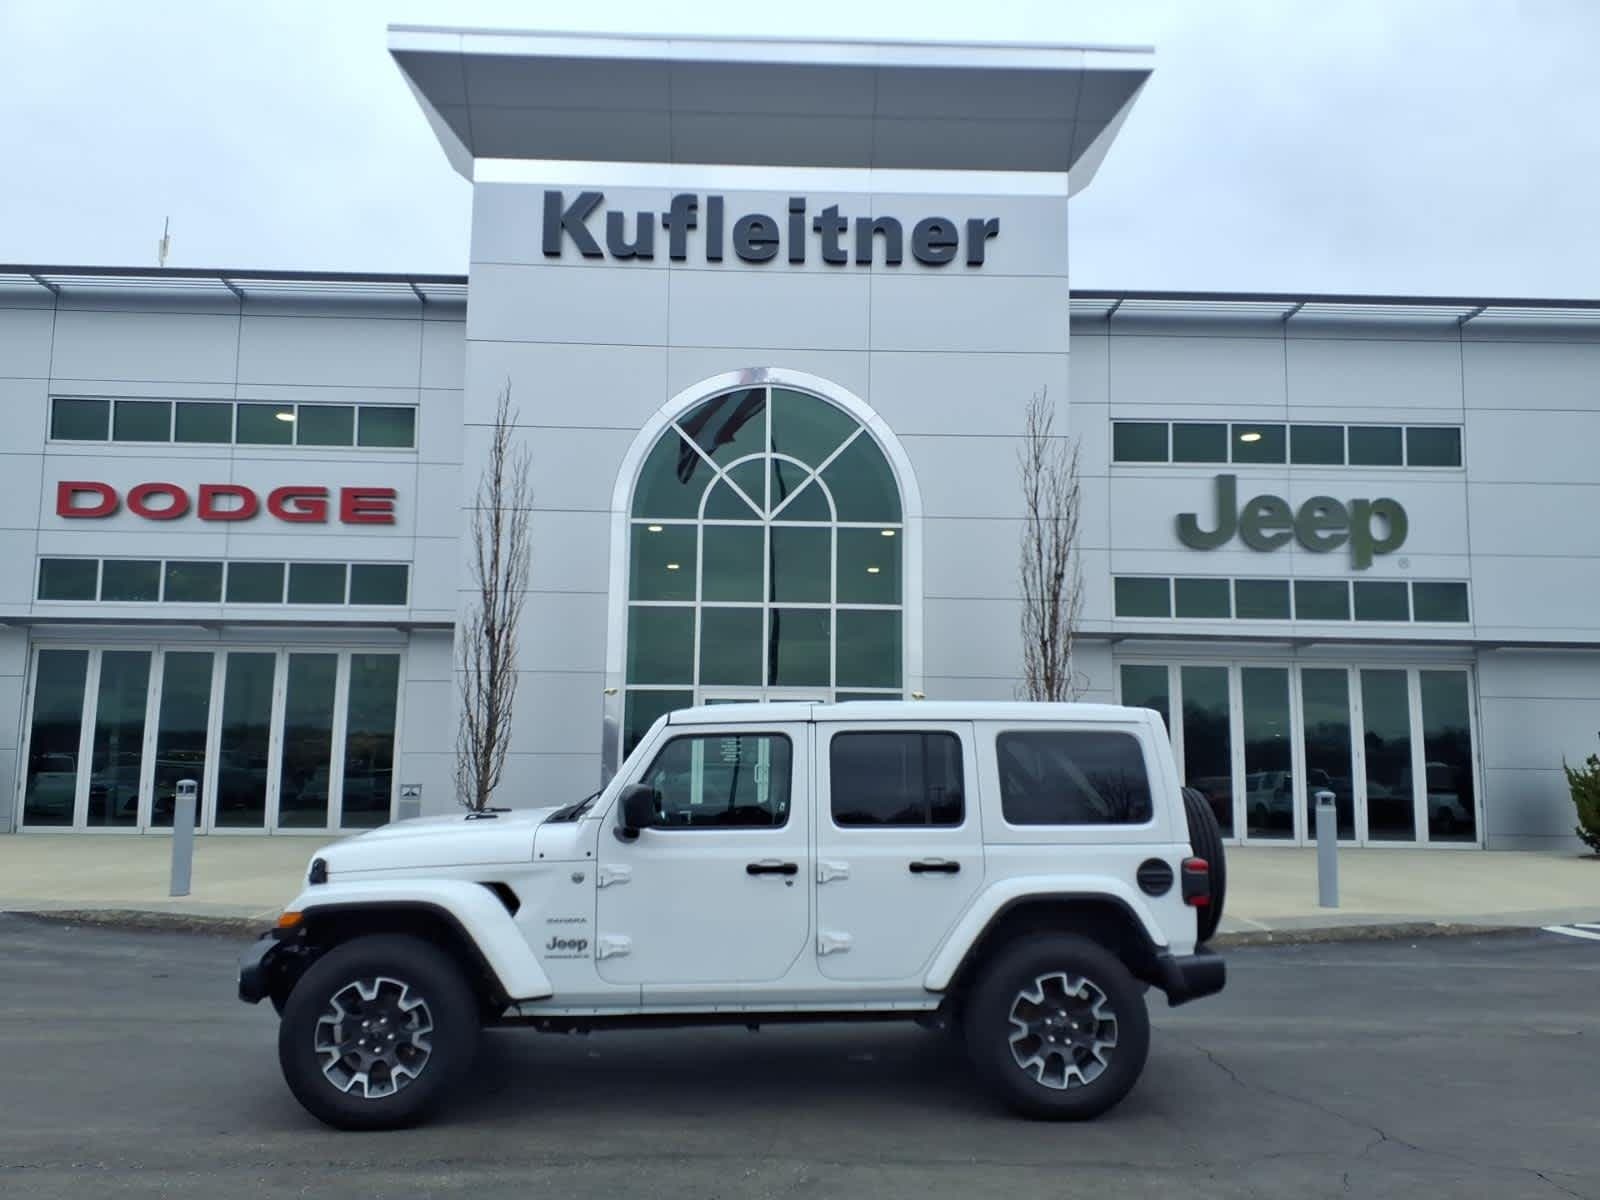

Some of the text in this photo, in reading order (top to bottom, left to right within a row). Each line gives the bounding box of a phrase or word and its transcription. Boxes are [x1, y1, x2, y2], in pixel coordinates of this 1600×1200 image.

[542, 190, 1000, 267] Kufleitner
[56, 481, 396, 525] DODGE
[1176, 474, 1408, 570] Jeep
[546, 936, 588, 952] Jeep
